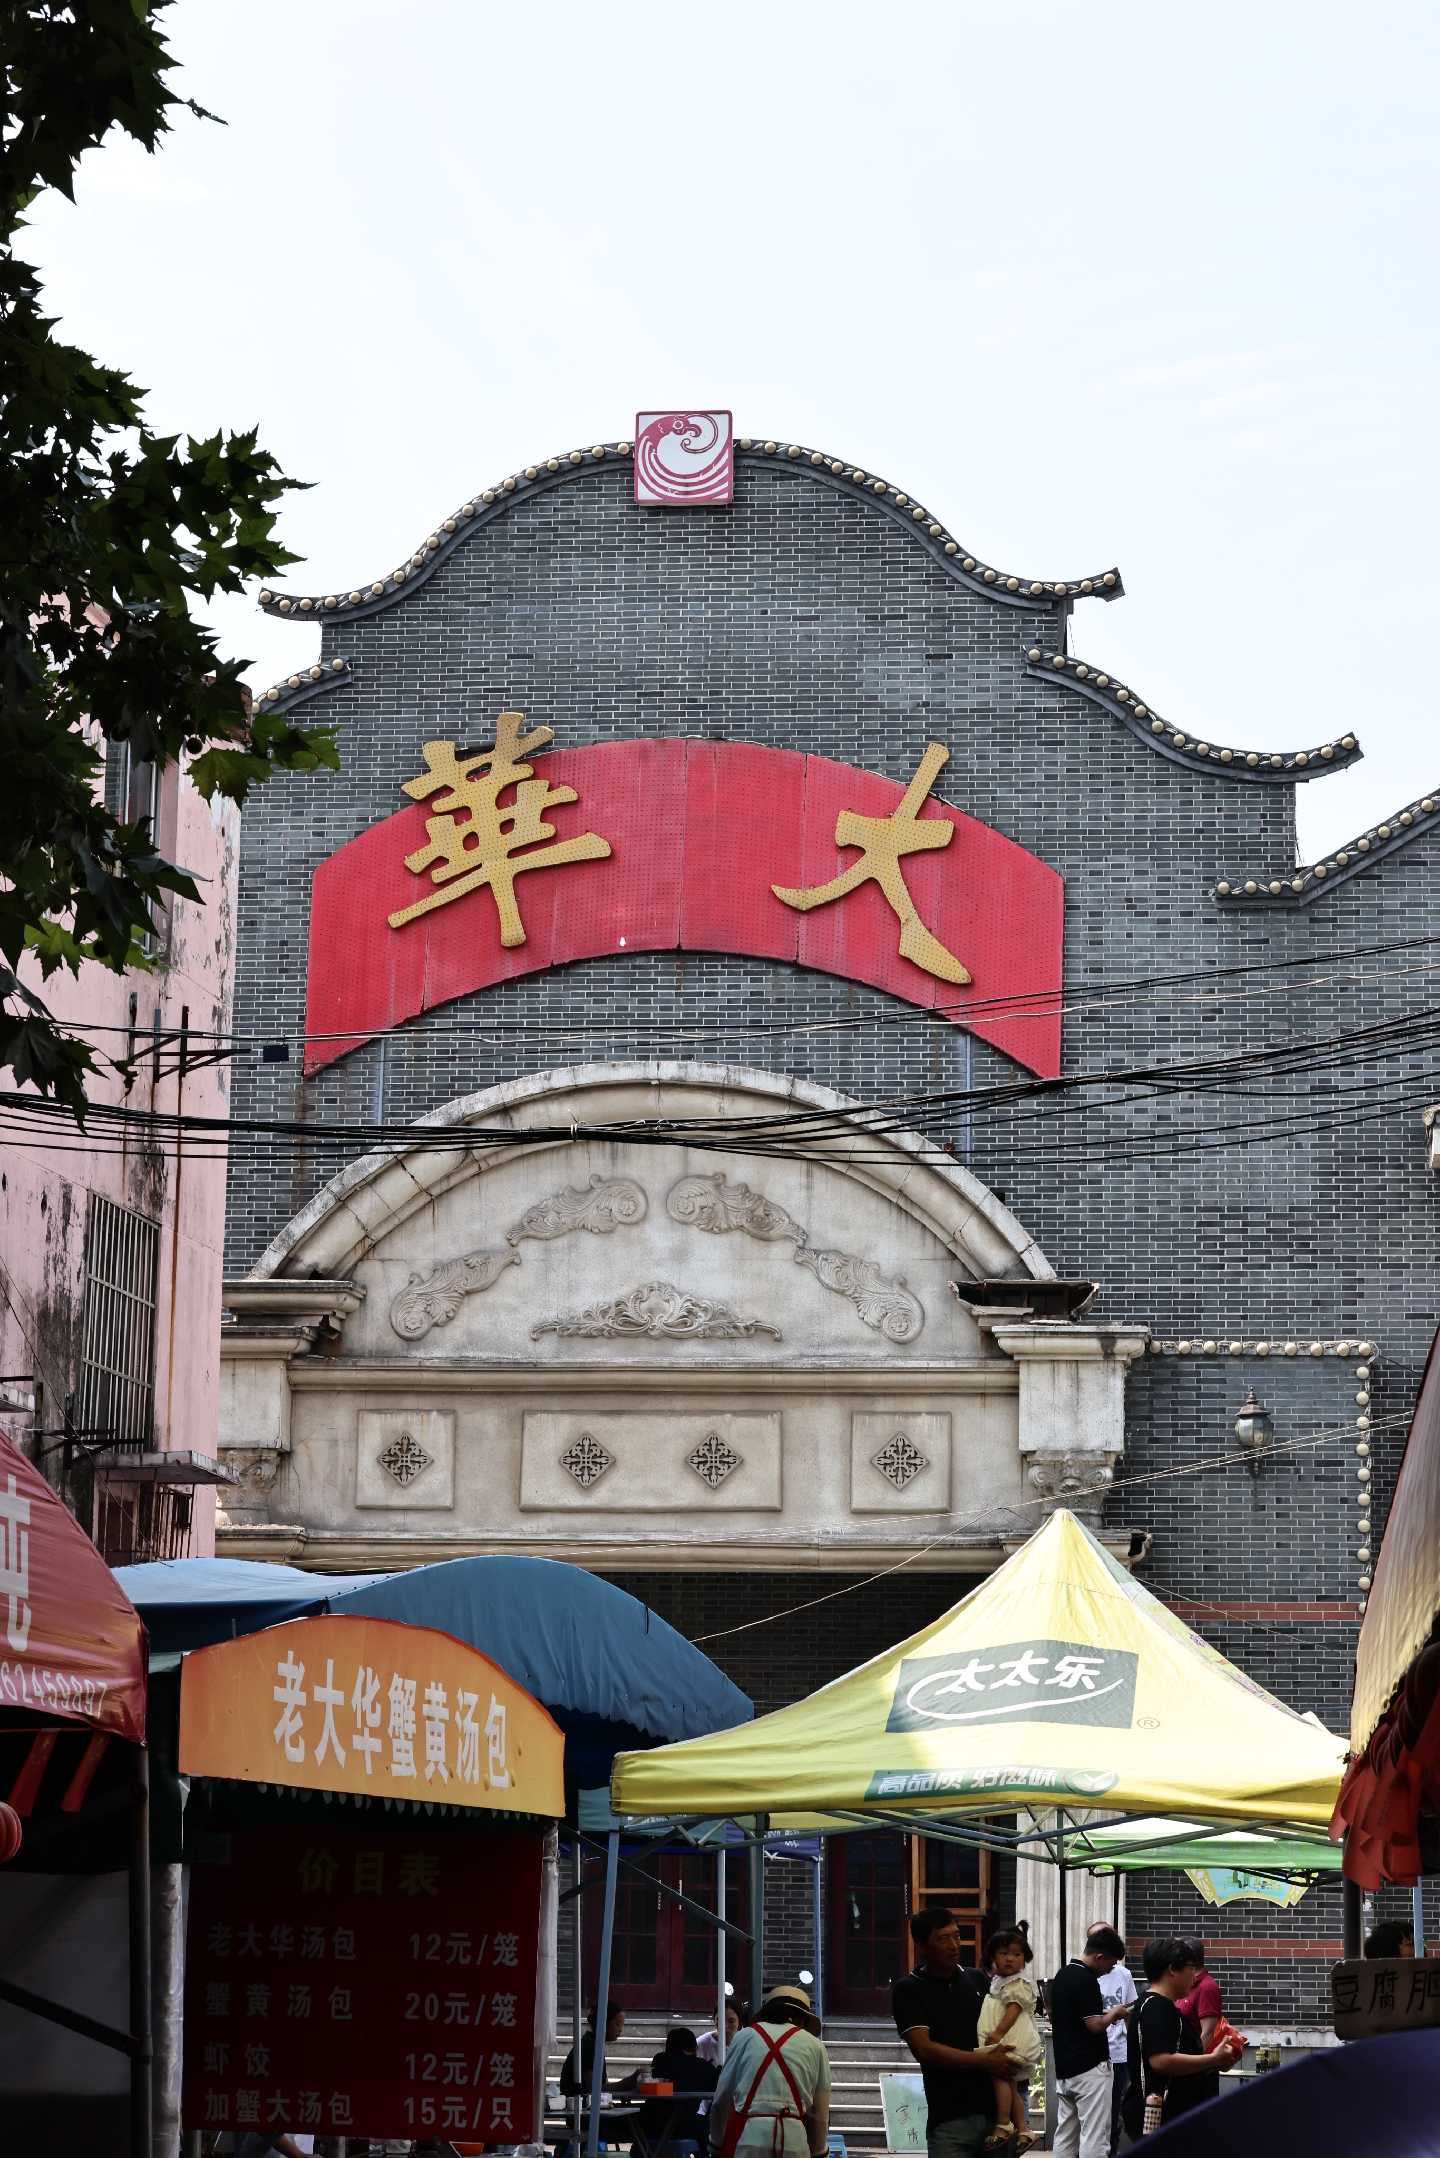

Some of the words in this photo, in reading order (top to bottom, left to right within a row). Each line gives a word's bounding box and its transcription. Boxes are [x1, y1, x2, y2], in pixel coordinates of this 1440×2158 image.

[0, 1661, 107, 1719] 62459897
[933, 1649, 1105, 1696] 太太乐
[273, 1650, 509, 1788] 老大华蟹黄汤包
[877, 1770, 967, 1795] 高品质
[971, 1767, 1060, 1789] 好滋味
[298, 1848, 441, 1896] 价目表
[208, 1922, 357, 1961] 老大华汤包
[409, 1931, 520, 1967] 12元/笼
[205, 1981, 353, 2020] 蟹黄汤包
[404, 1991, 518, 2027] 20元/笼
[203, 2041, 270, 2078] 虾饺
[405, 2051, 515, 2088] 12元/笼
[204, 2088, 354, 2126] 加蟹大汤包
[403, 2096, 514, 2131] 15元/只
